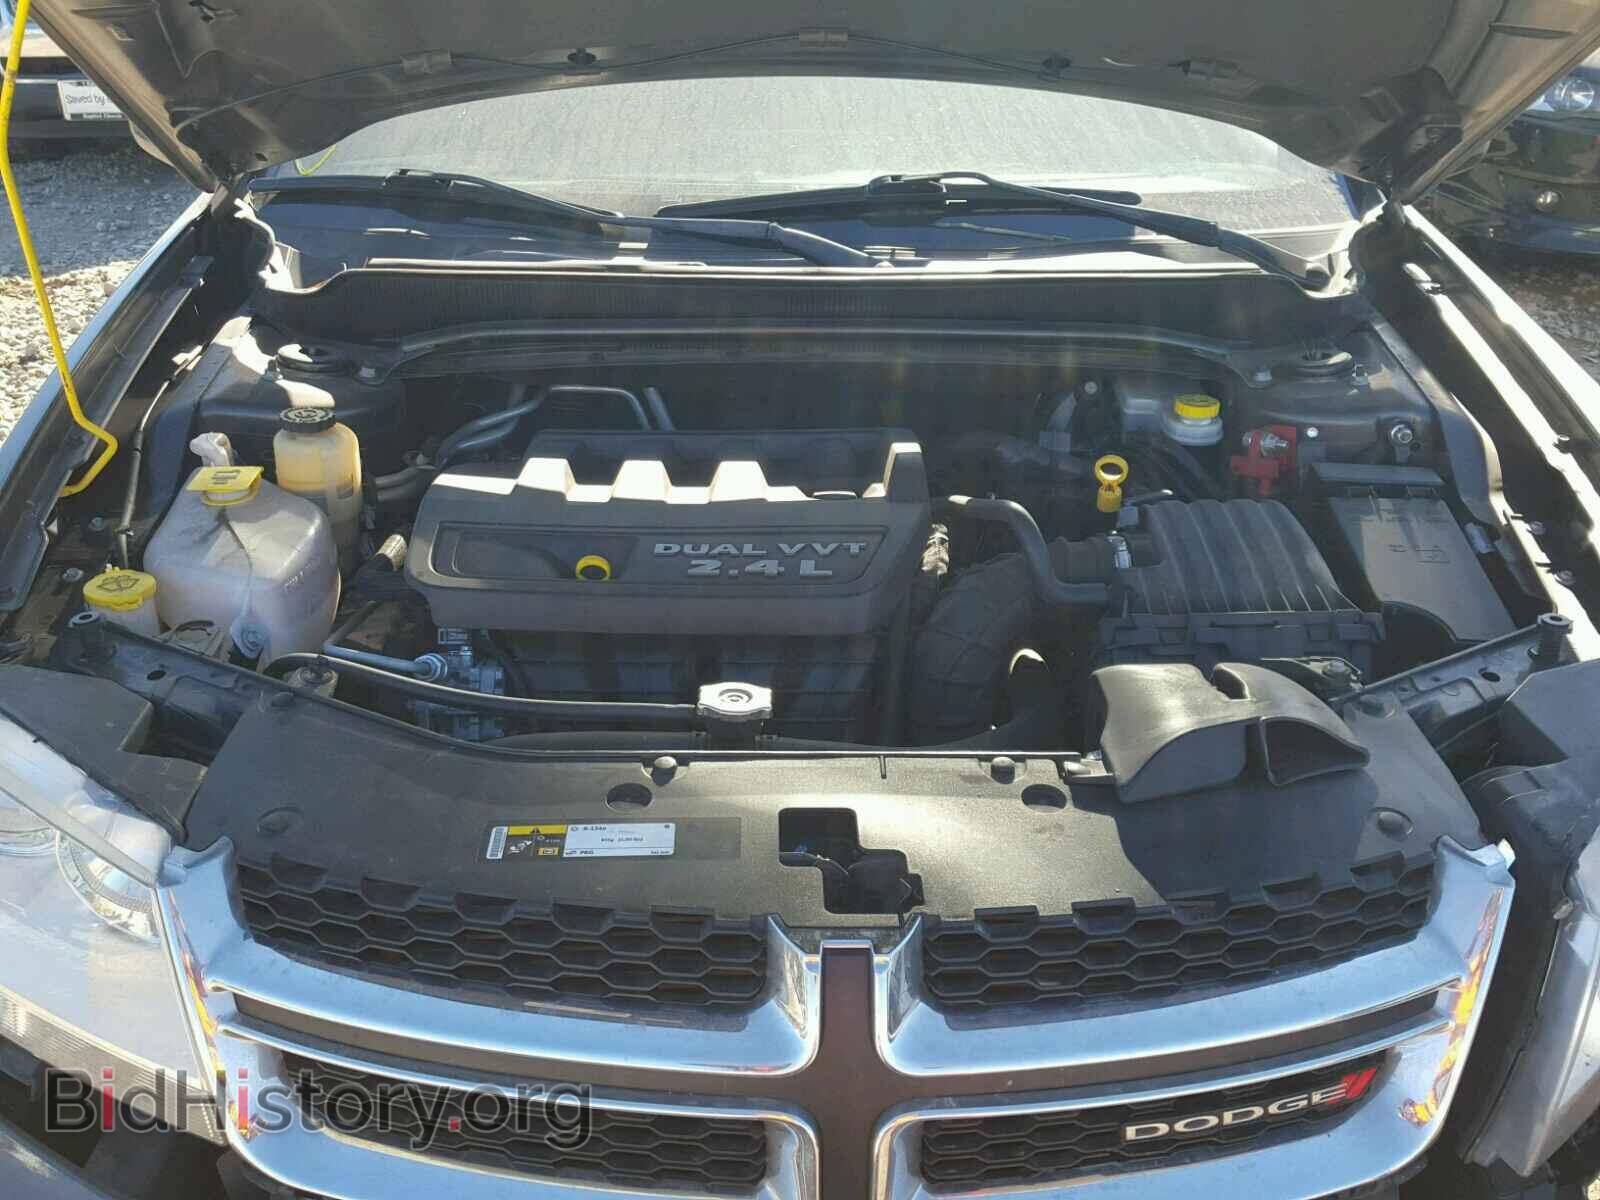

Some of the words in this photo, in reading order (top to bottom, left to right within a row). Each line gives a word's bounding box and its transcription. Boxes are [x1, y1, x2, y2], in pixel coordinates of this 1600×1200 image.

[653, 543, 768, 555] DUAL
[778, 543, 867, 555] VVT
[1125, 1082, 1348, 1142] DODGE
